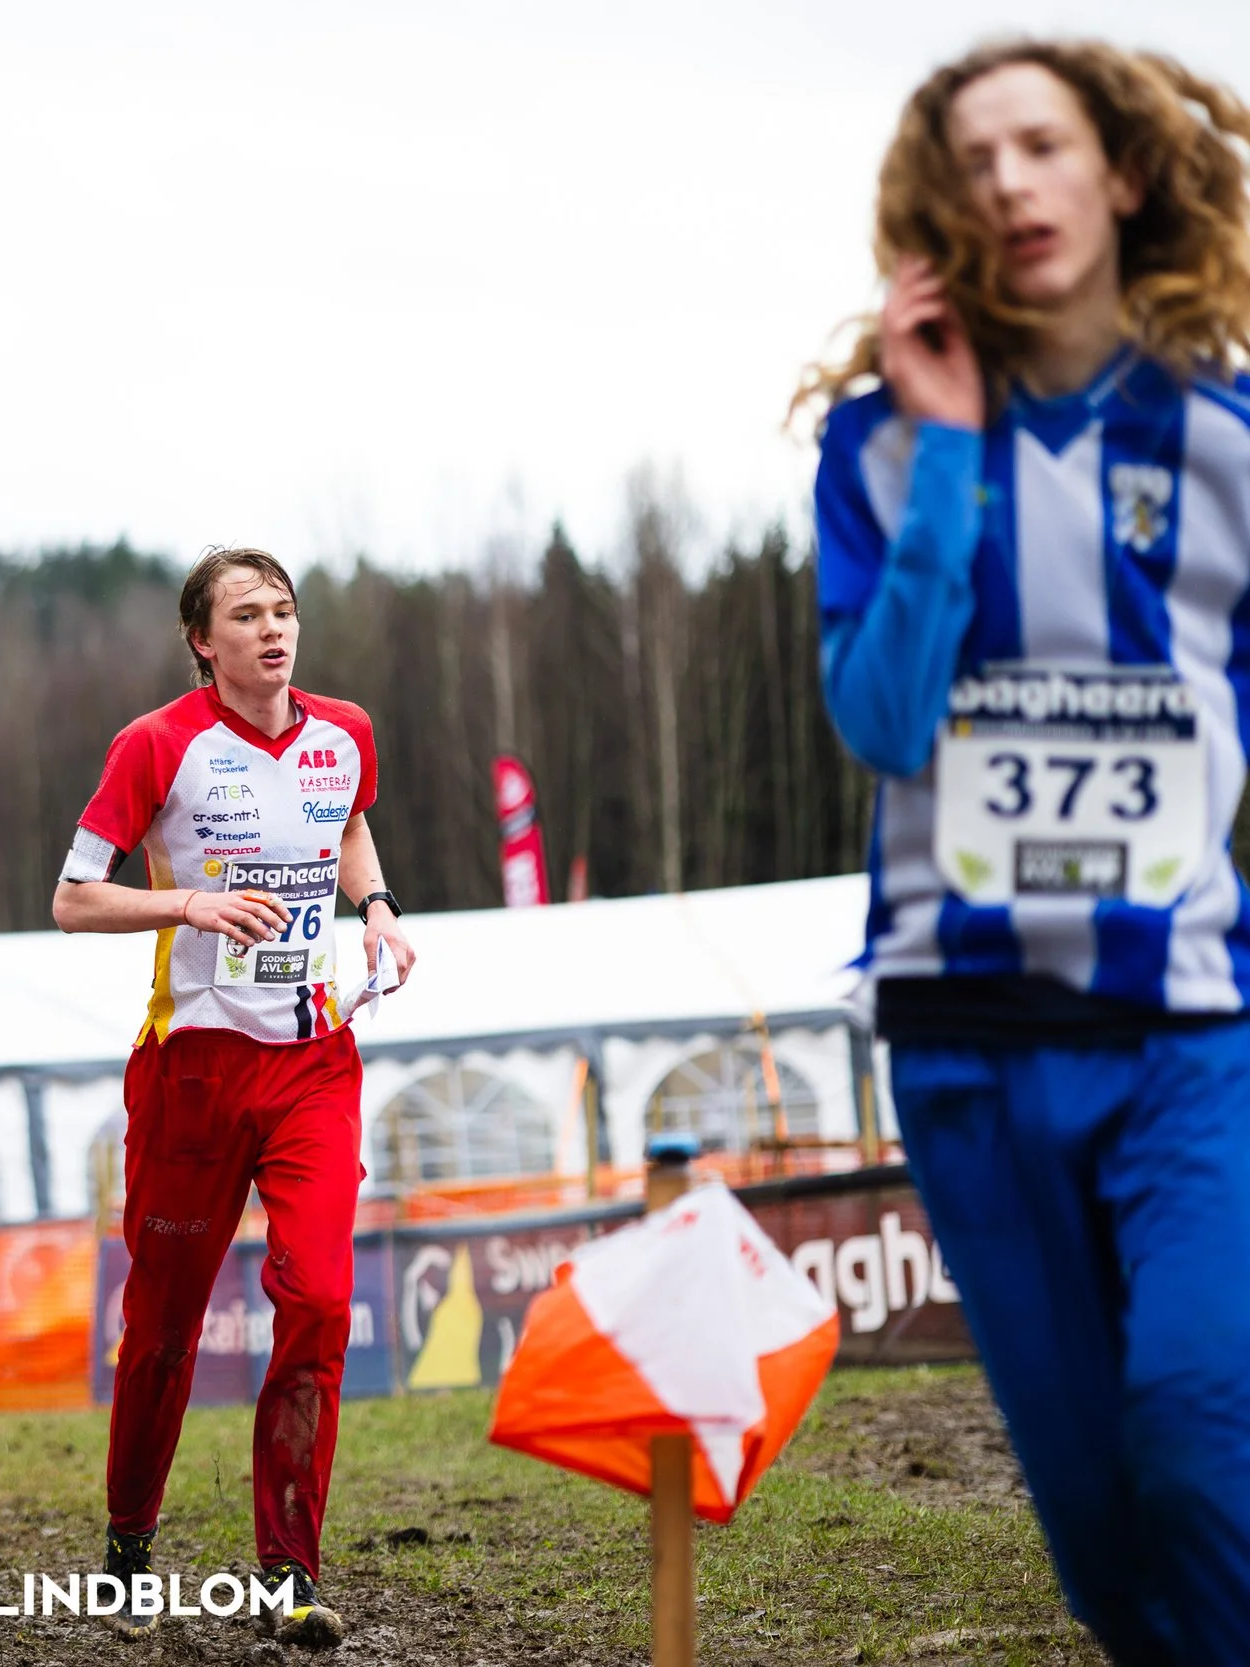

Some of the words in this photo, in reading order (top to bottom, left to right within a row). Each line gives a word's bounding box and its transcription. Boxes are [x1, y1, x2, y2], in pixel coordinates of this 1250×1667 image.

[298, 750, 337, 768] ABB
[210, 765, 248, 775] Tryckeriet
[299, 774, 351, 787] VÄSTERÅS
[985, 752, 1159, 819] 373
[302, 801, 350, 823] Kadesjös
[216, 832, 261, 842] Etteplan
[204, 846, 261, 855] noname
[230, 864, 337, 888] bagheera
[262, 903, 322, 941] 76
[261, 954, 305, 963] GODKÄNDA
[260, 962, 304, 973] AVLOPP
